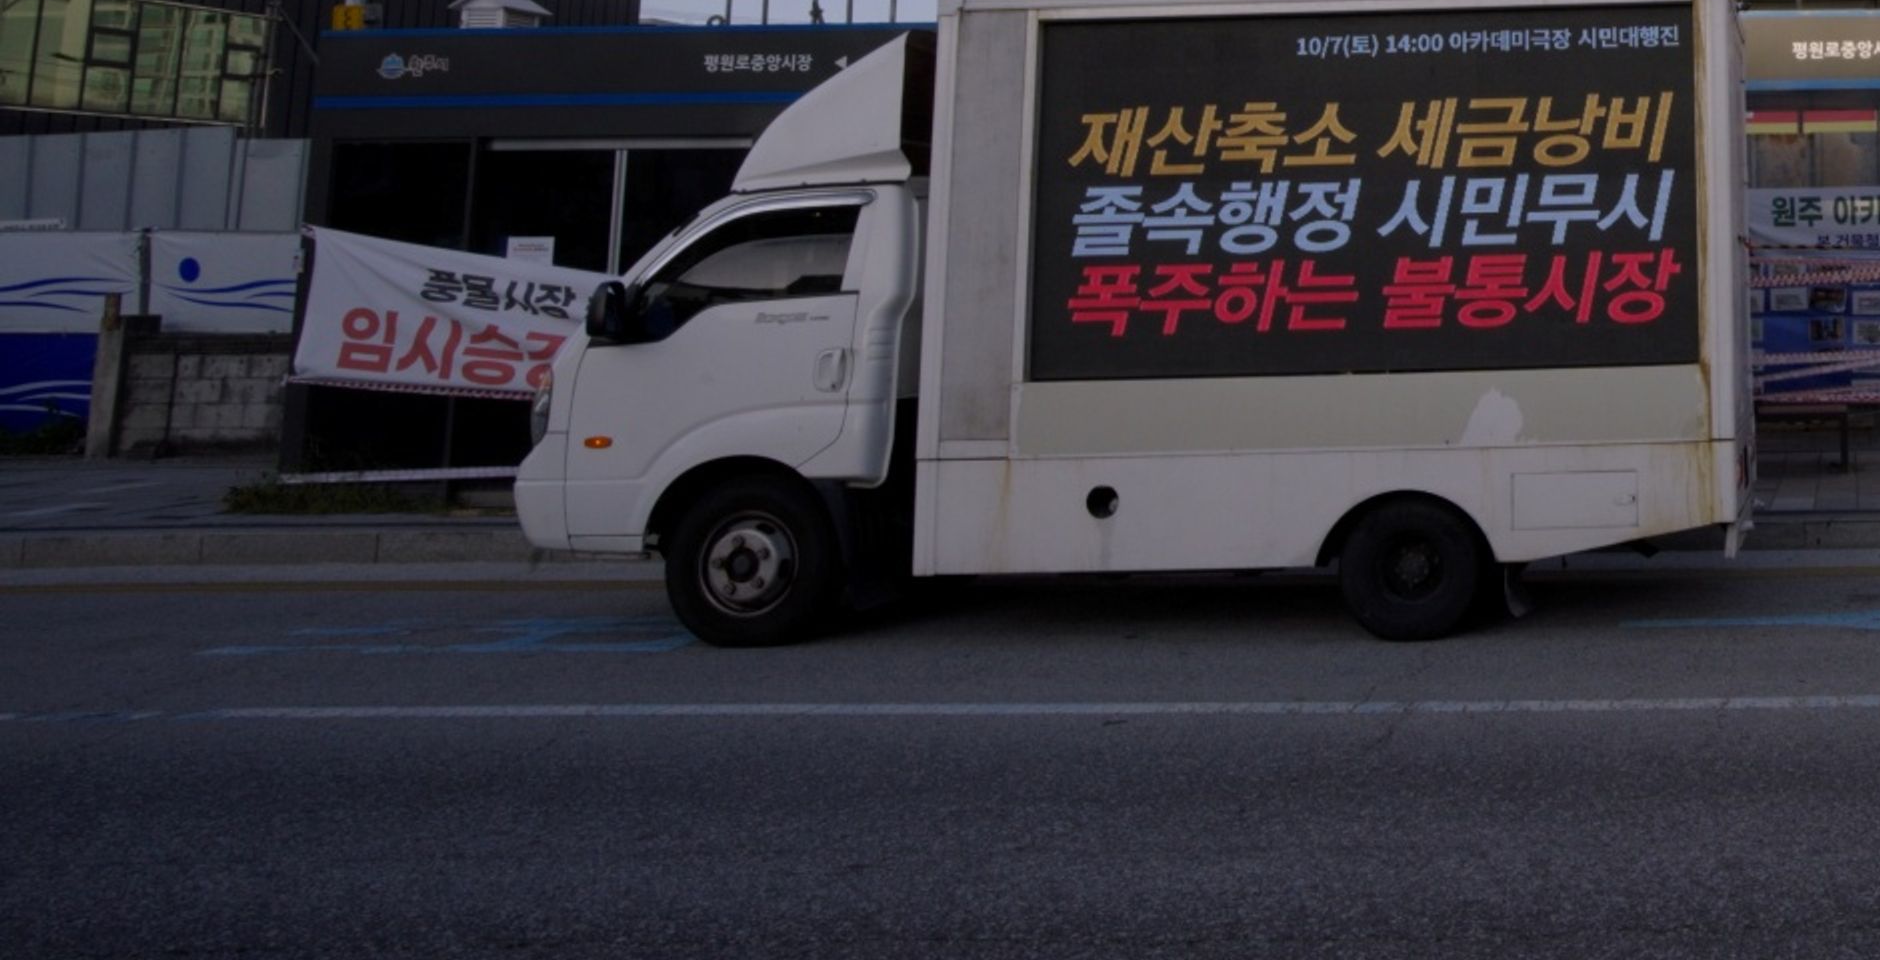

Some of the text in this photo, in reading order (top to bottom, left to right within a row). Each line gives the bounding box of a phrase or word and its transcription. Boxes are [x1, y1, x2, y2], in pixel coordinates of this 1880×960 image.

[703, 53, 812, 73] 평원로중앙시장
[1296, 25, 1680, 59] 10/7(토) 14:00 아카데미극장 시민대행진
[1068, 91, 1673, 178] 재산축소 세금낭비
[1070, 168, 1673, 257] 졸속행정 시민무시
[1771, 197, 1823, 228] 원주
[420, 268, 576, 319] 풍물시장
[1068, 247, 1681, 336] 폭주하는 불통시장
